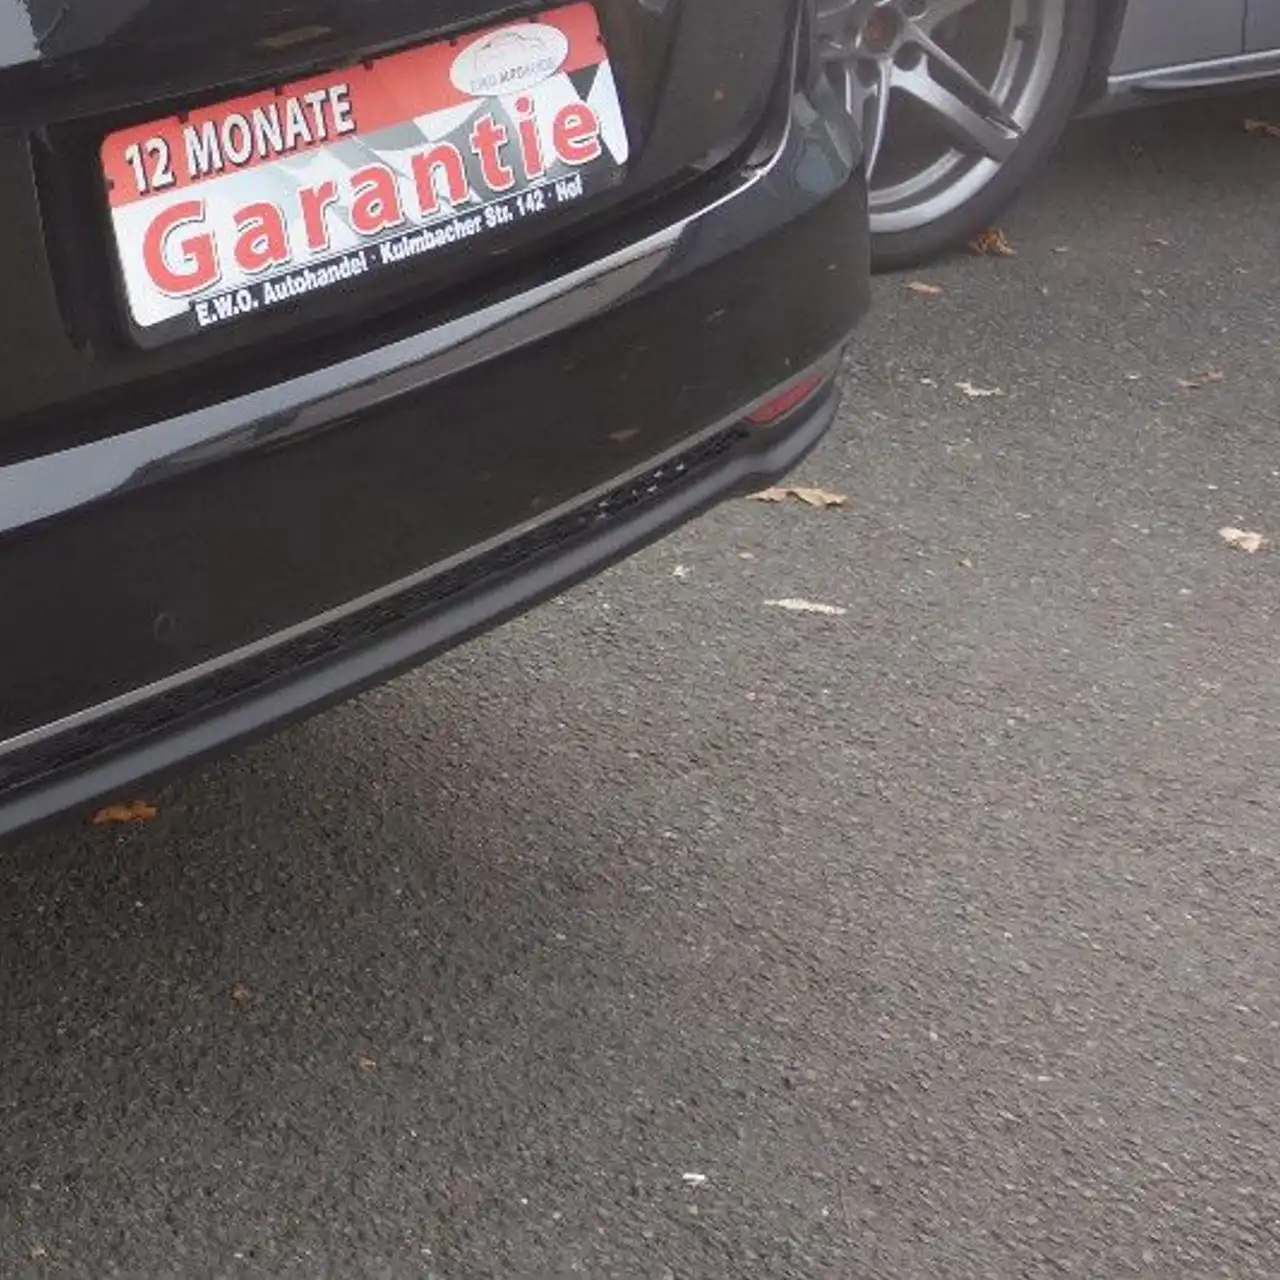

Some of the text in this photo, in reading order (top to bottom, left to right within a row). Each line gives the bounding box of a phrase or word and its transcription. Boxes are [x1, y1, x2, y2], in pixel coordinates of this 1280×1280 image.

[125, 83, 356, 194] 12 MONATE
[141, 96, 603, 298] Garantie
[194, 174, 584, 326] E.W.O. Autohandel Kulmbacher Str. 142 Hof
